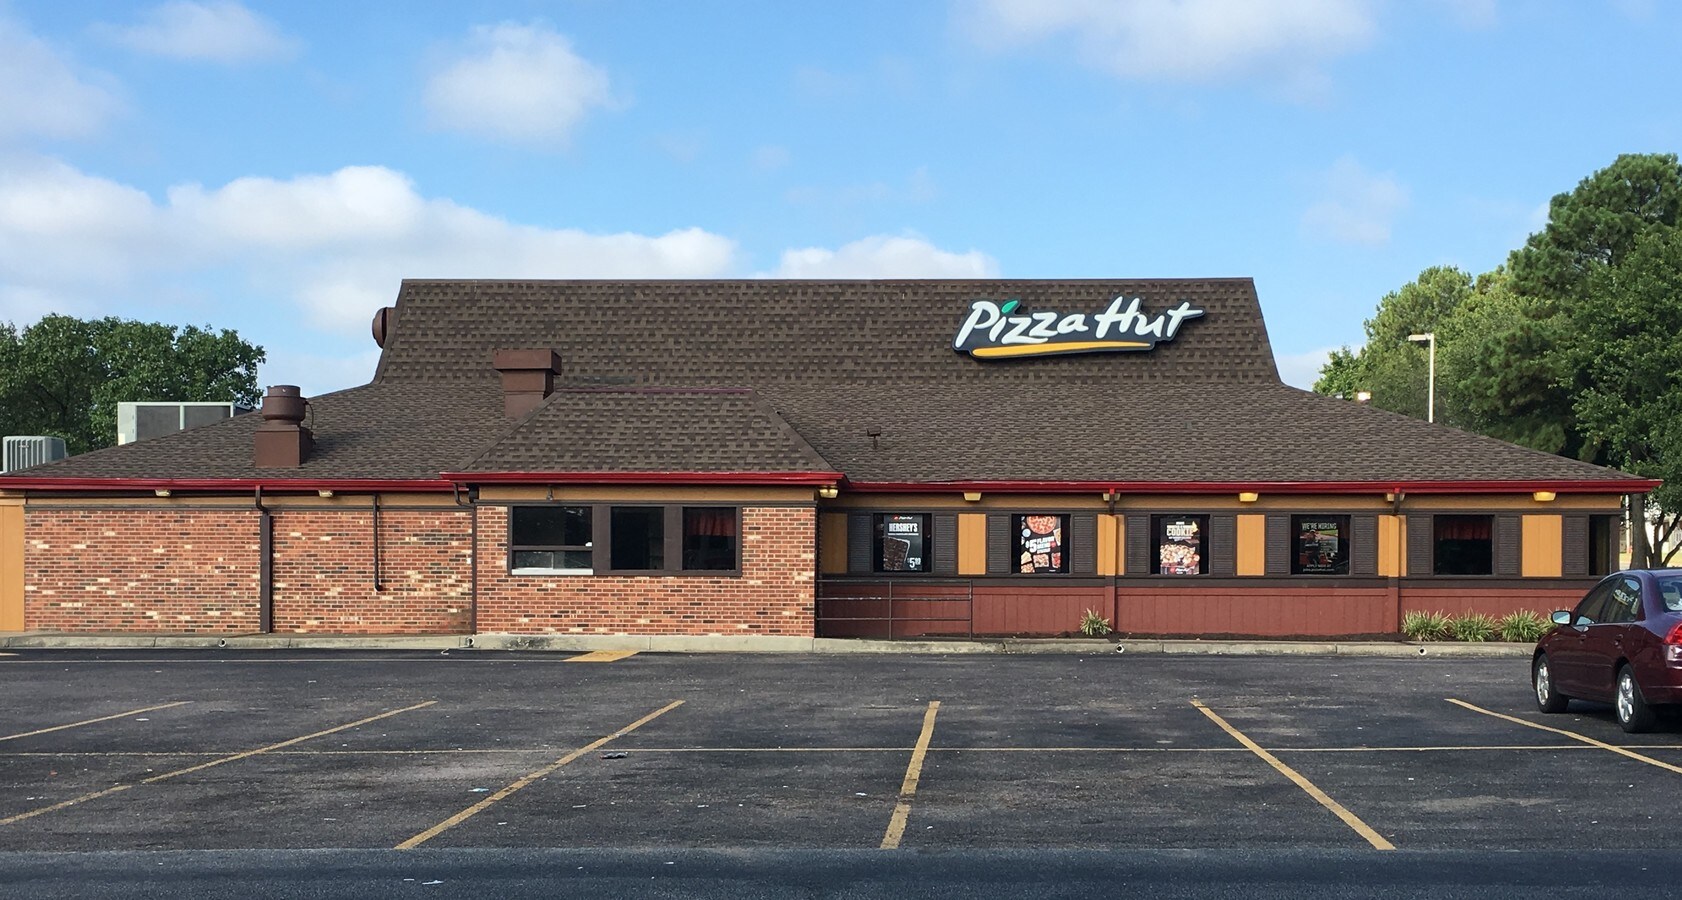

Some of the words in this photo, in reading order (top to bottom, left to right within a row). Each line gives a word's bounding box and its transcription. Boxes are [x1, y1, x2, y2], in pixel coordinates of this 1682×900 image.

[955, 300, 1089, 348] Pizza
[1095, 296, 1204, 338] Hut
[888, 522, 918, 532] HERSHEY'S
[1301, 522, 1318, 530] WE'RE
[1318, 522, 1337, 530] HIRING
[1166, 528, 1194, 537] COOKIE
